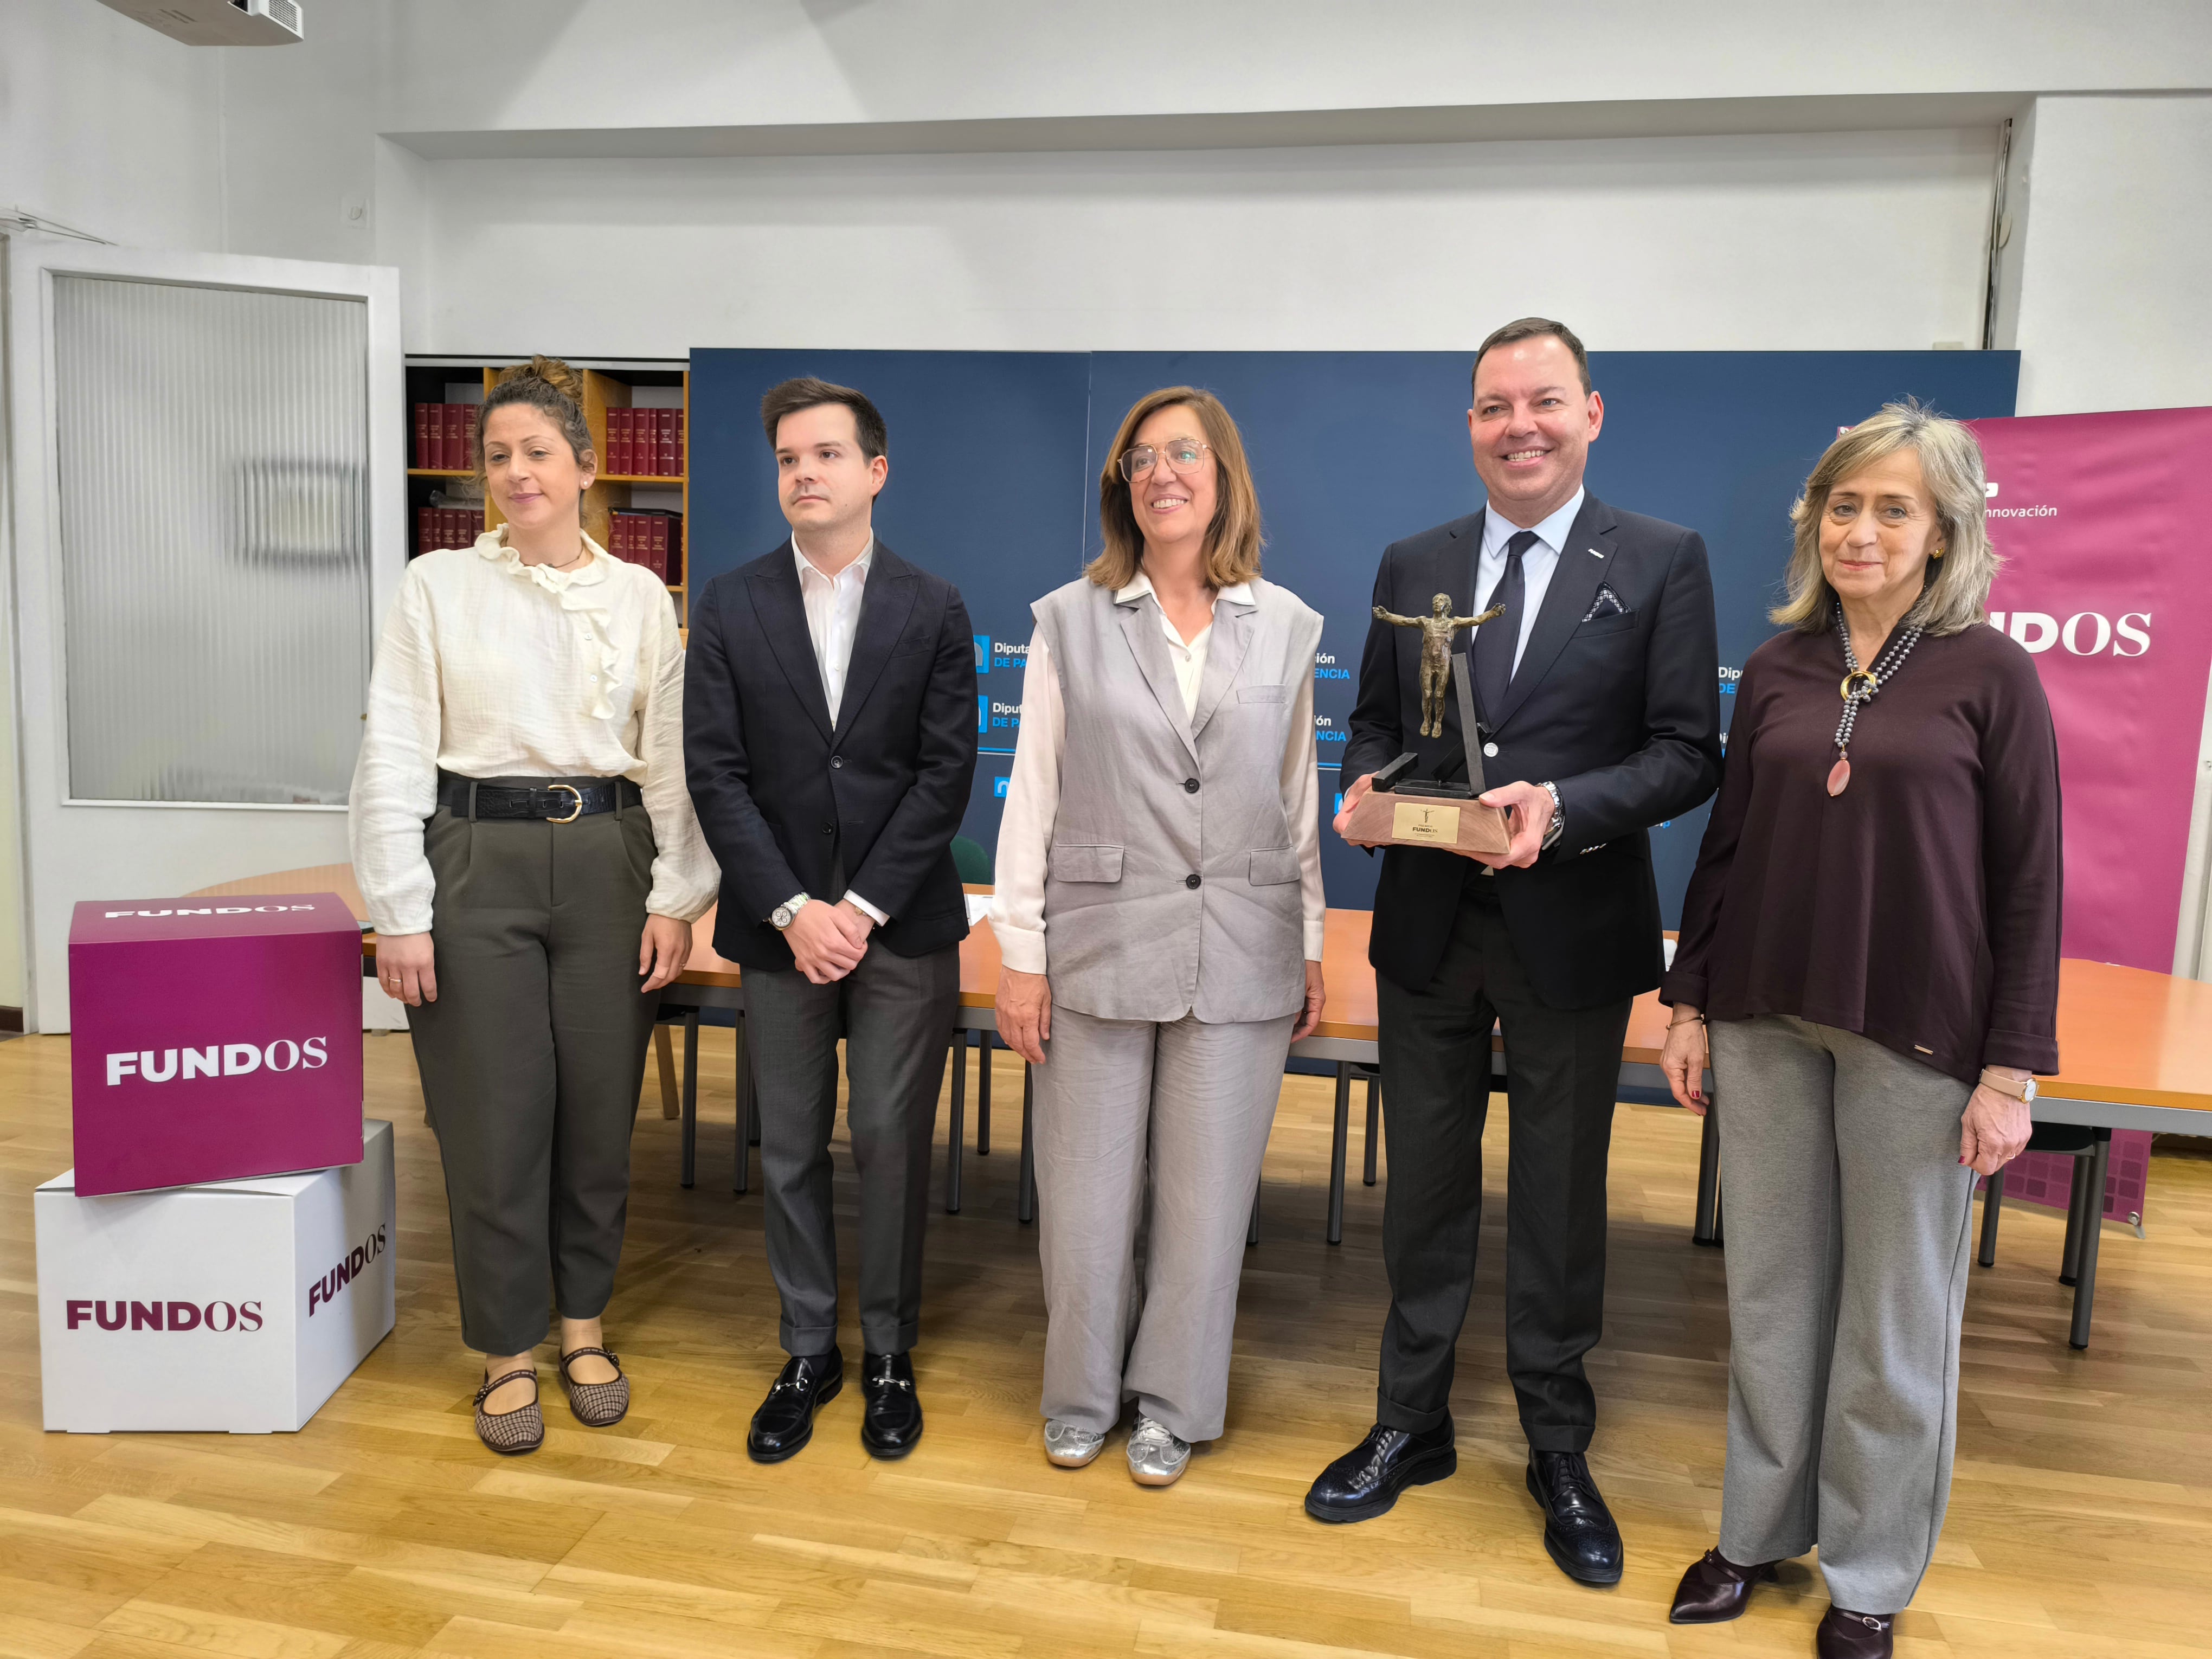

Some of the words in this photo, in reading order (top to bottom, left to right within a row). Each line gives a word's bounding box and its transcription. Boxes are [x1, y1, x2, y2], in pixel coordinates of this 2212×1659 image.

[994, 657, 1010, 667] DE
[992, 717, 1008, 728] DE
[105, 905, 315, 918] FUNDOS
[107, 1037, 327, 1085] FUNDOS
[309, 1223, 385, 1317] FUNDOS
[66, 1300, 263, 1332] FUNDOS
